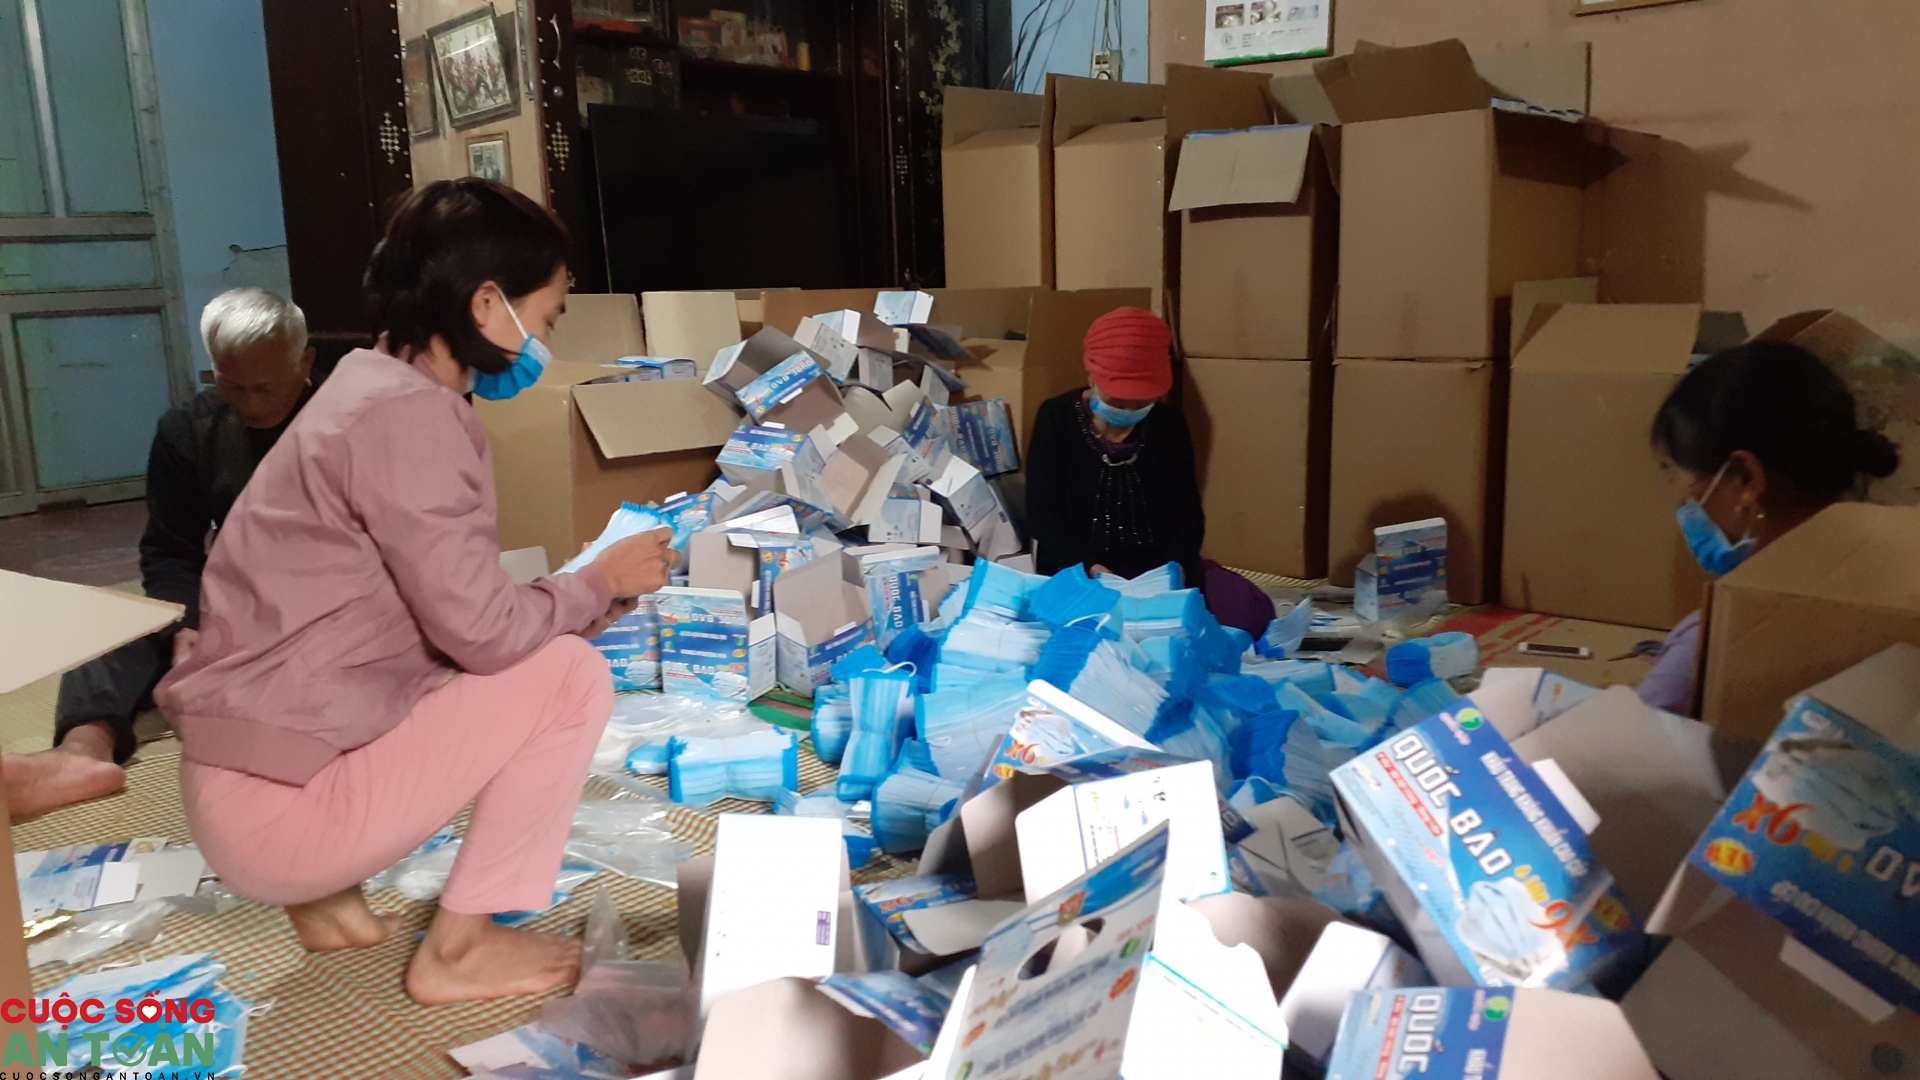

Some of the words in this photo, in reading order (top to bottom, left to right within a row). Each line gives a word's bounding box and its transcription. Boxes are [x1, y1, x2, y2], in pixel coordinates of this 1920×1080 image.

[1390, 734, 1462, 808] QUỐC
[1450, 807, 1513, 876] BẢO
[1397, 993, 1444, 1074] QUỐC
